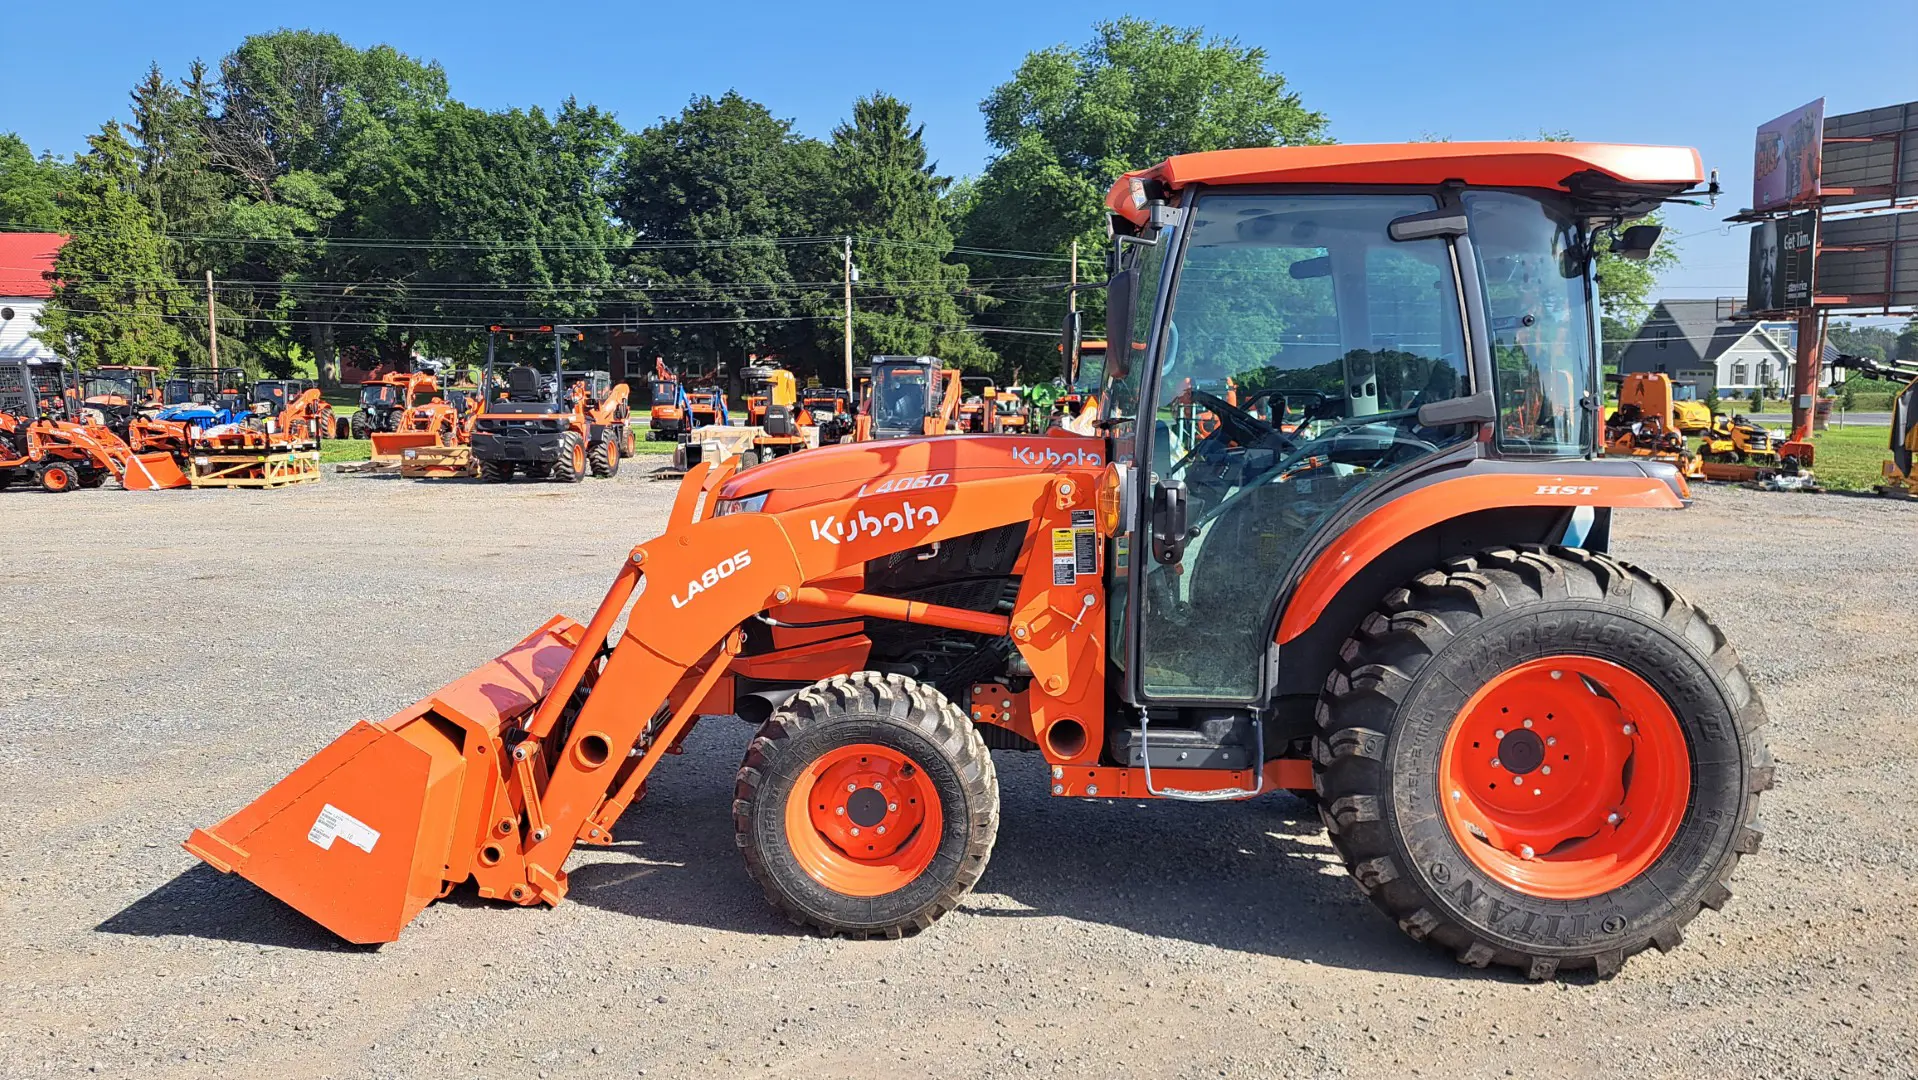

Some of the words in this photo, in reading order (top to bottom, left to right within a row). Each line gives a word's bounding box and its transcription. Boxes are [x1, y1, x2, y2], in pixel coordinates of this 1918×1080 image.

[1783, 233, 1796, 251] Get
[1012, 446, 1102, 466] Kubota
[1534, 485, 1599, 495] HST
[809, 501, 940, 545] Kubota
[670, 548, 752, 609] LA805
[1444, 879, 1598, 941] TITAN
